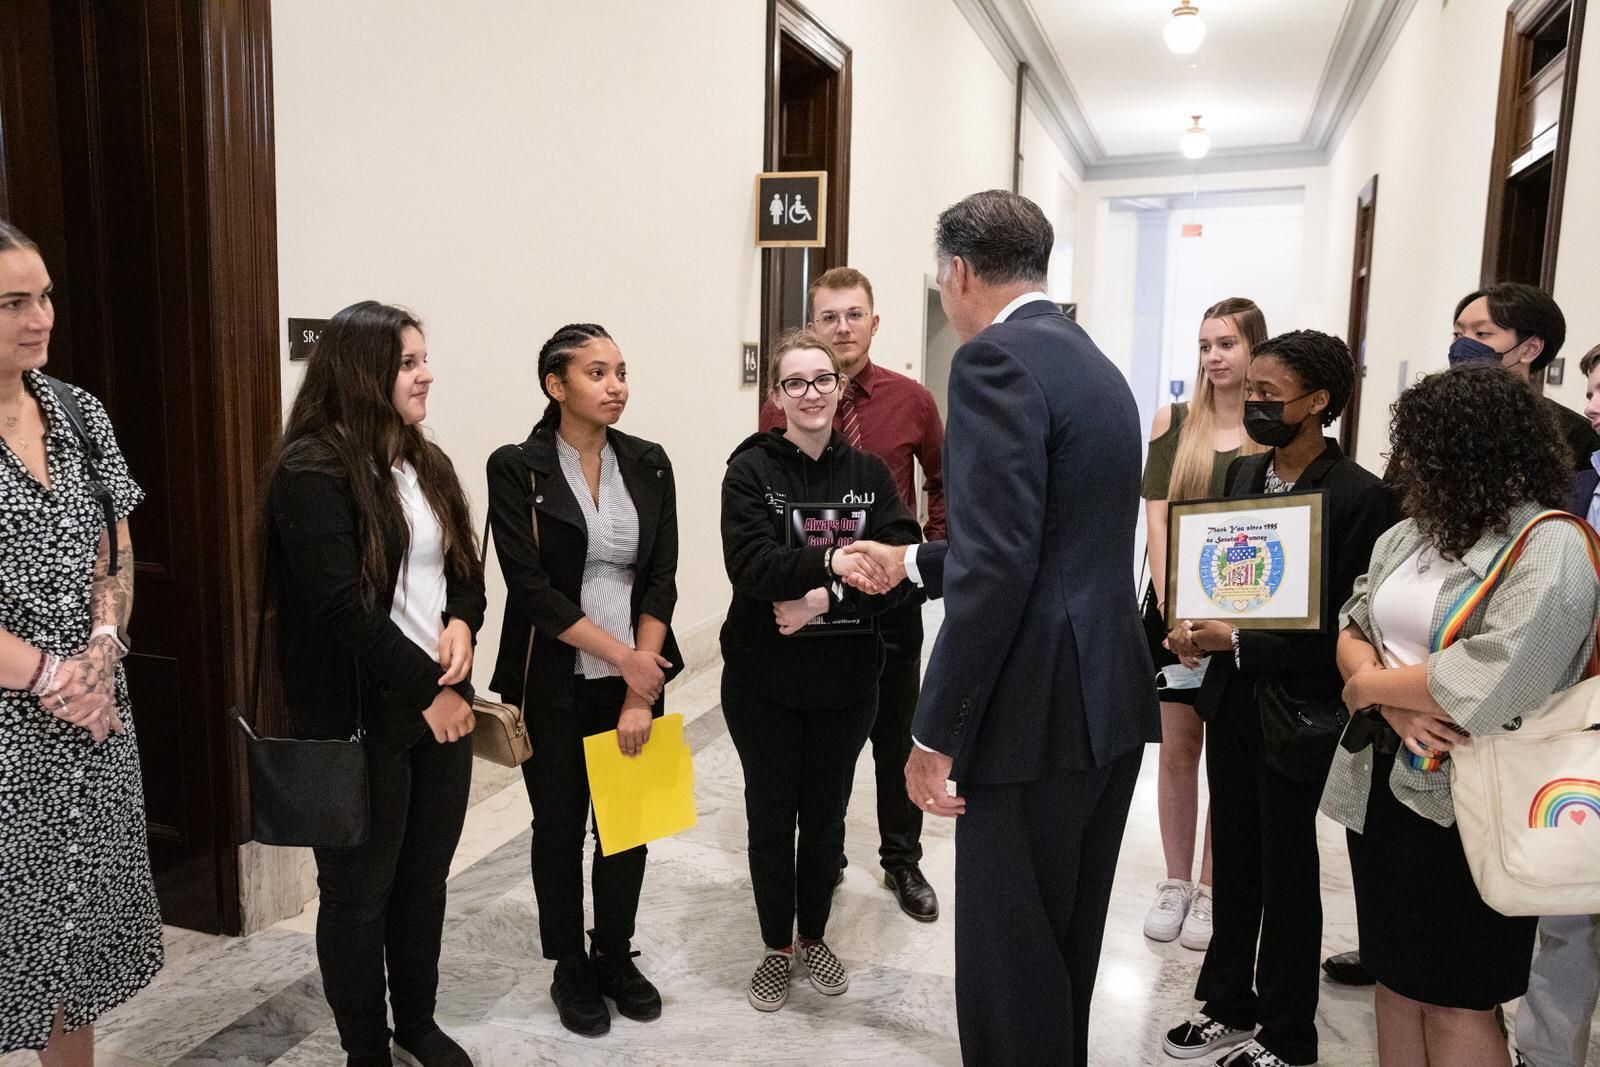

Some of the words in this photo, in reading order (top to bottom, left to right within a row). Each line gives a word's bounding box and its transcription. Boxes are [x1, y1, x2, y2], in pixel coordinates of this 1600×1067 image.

[804, 517, 840, 532] Always
[840, 517, 858, 531] Our
[1207, 526, 1227, 534] Thank
[1230, 525, 1244, 533] You
[1215, 536, 1239, 544] Senator
